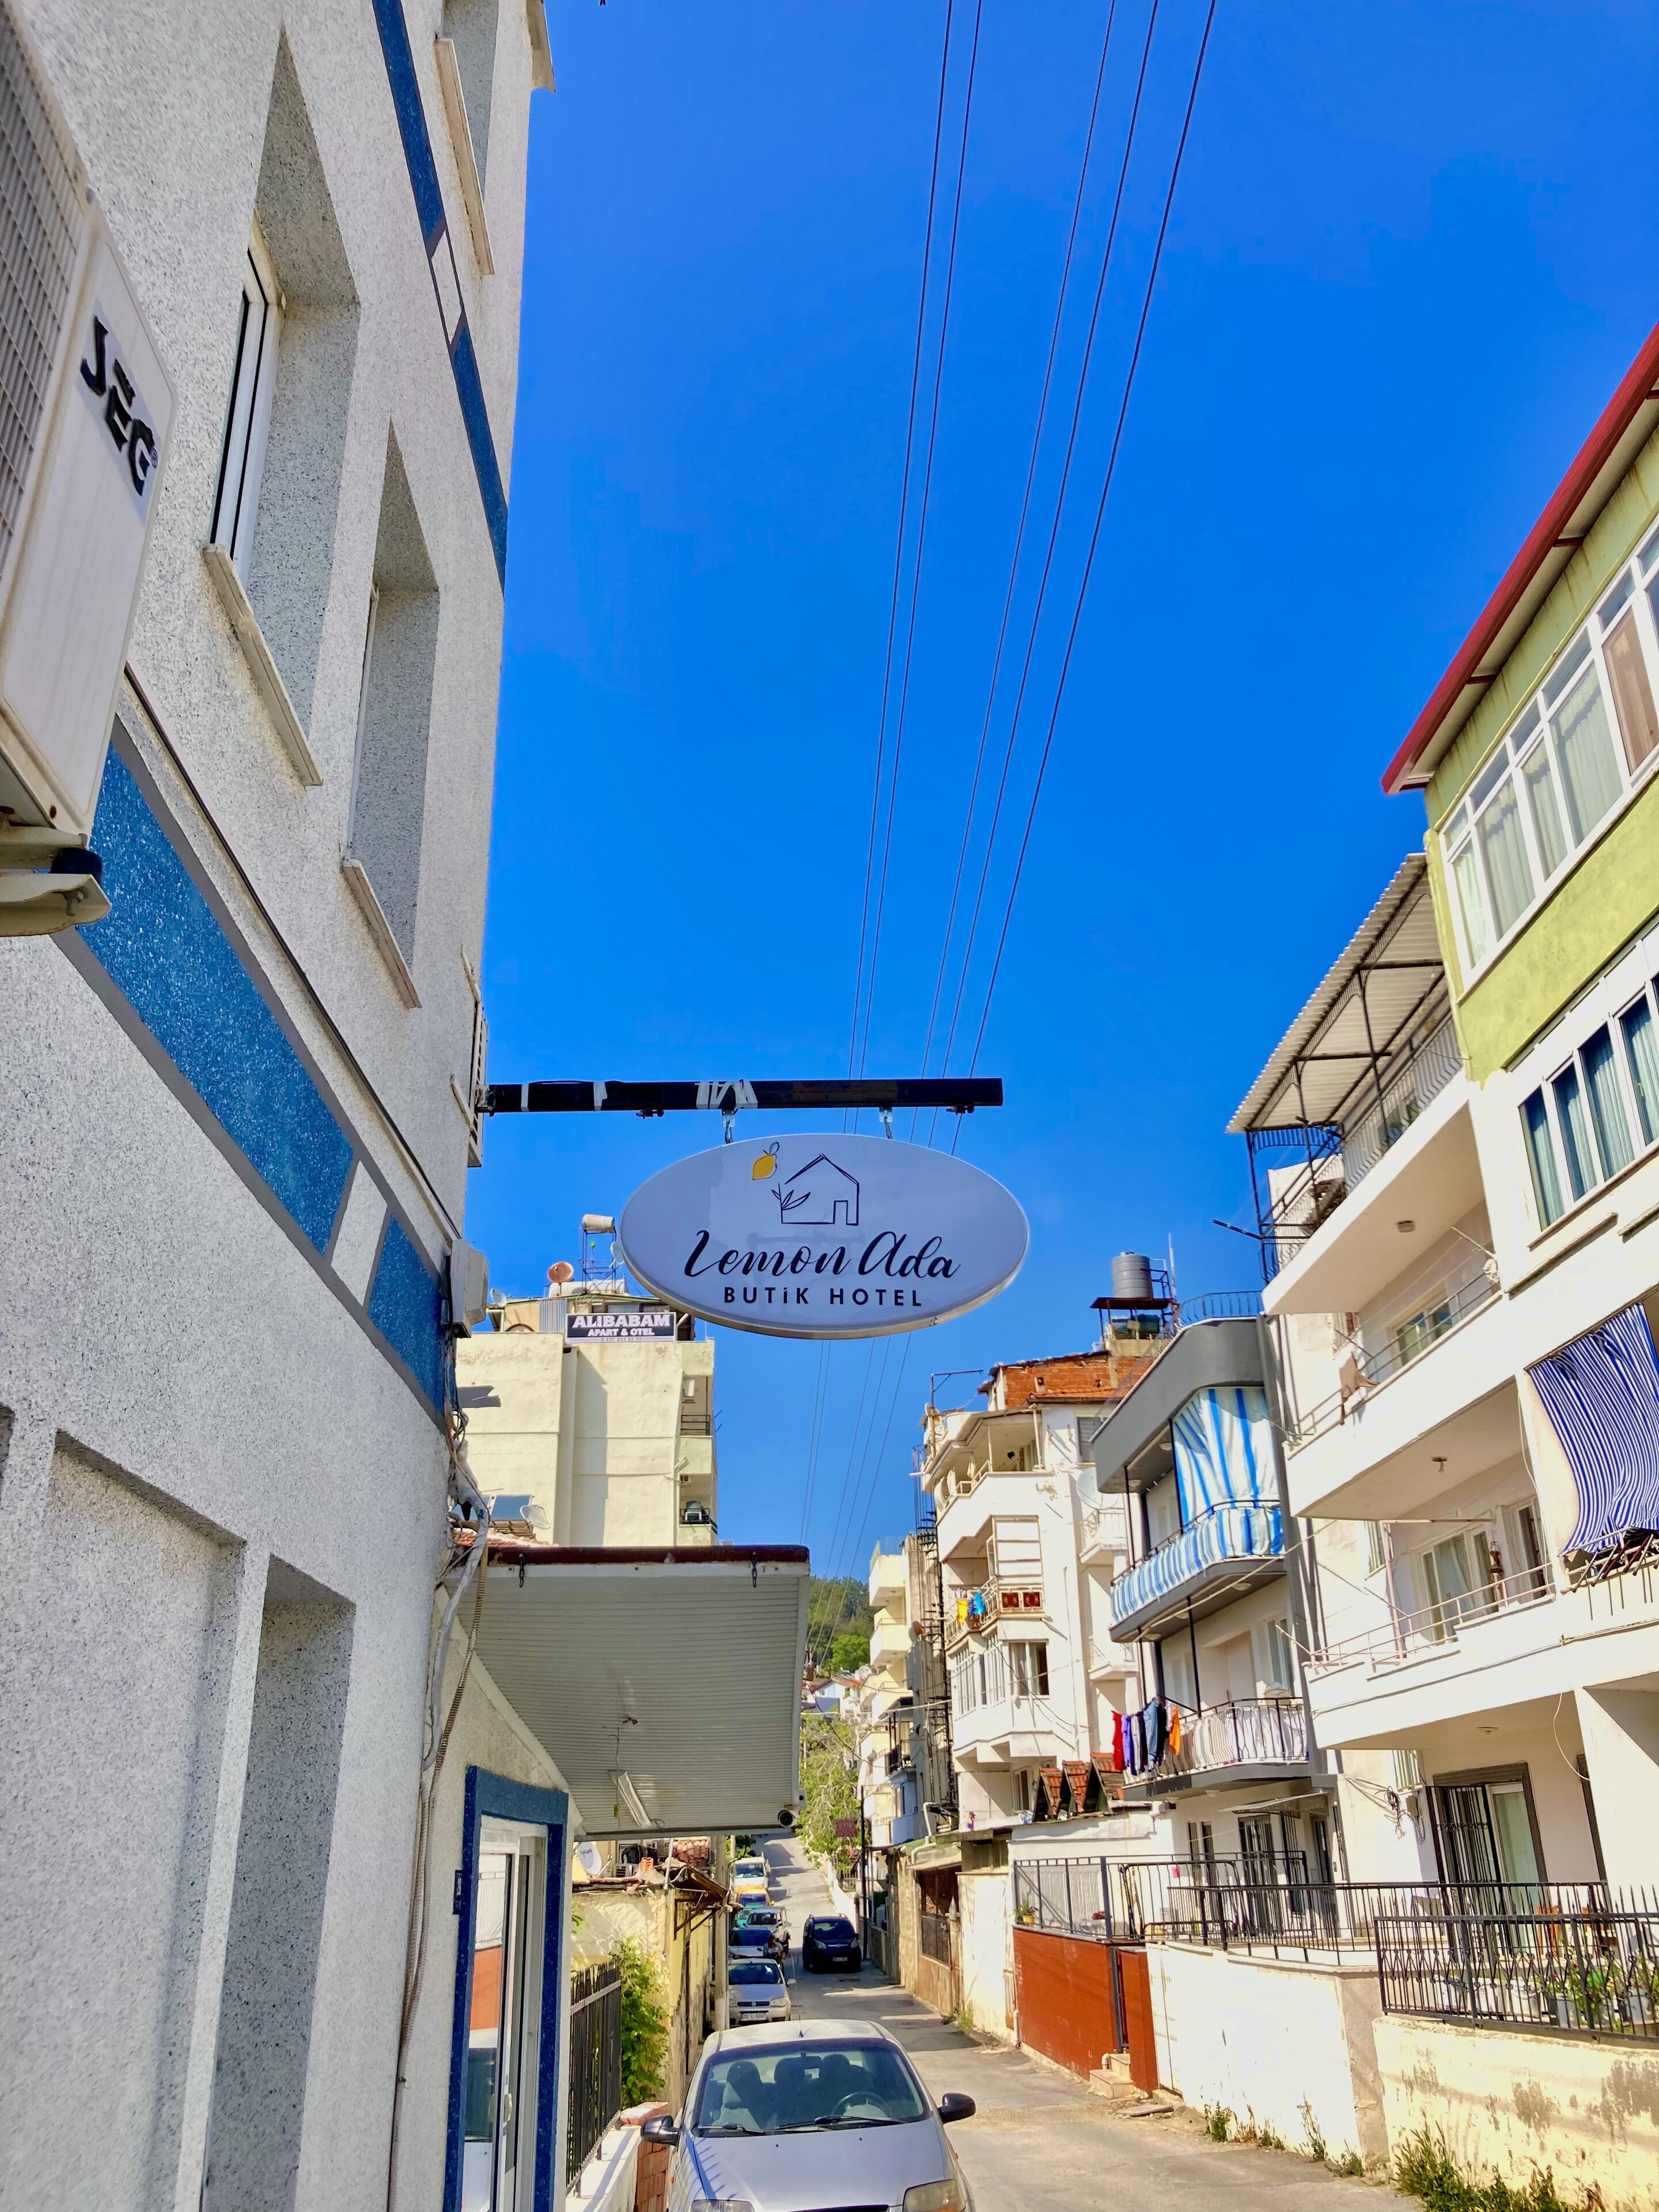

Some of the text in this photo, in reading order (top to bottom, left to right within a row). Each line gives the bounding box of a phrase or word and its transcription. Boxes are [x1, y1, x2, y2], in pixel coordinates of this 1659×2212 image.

[684, 1230, 961, 1278] Lemon Ada
[830, 1287, 922, 1306] HOTEL
[588, 1328, 619, 1336] APART
[630, 1328, 655, 1336] OTEL
